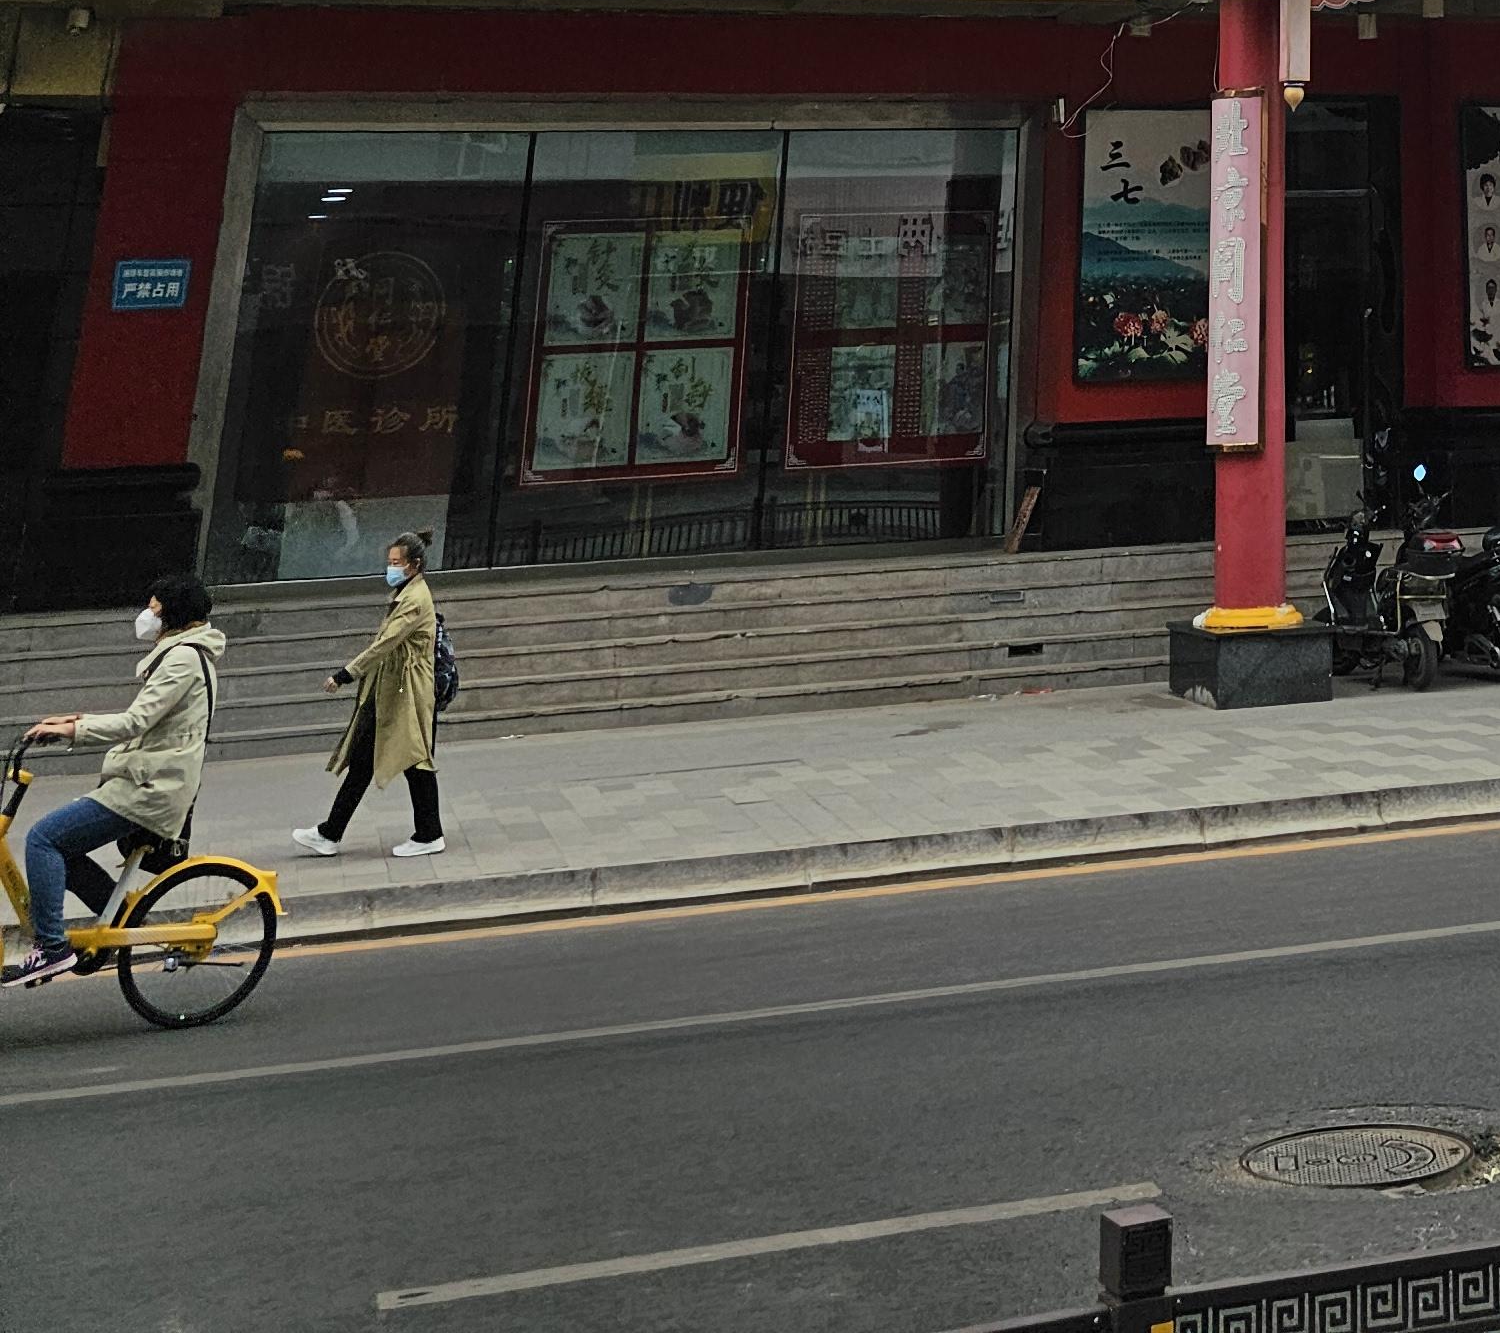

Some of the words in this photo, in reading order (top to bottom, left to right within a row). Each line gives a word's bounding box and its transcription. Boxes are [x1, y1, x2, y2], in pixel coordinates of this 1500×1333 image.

[1100, 141, 1143, 204] 三七
[122, 282, 180, 299] 严禁占用
[1211, 100, 1250, 437] 北京同仁堂
